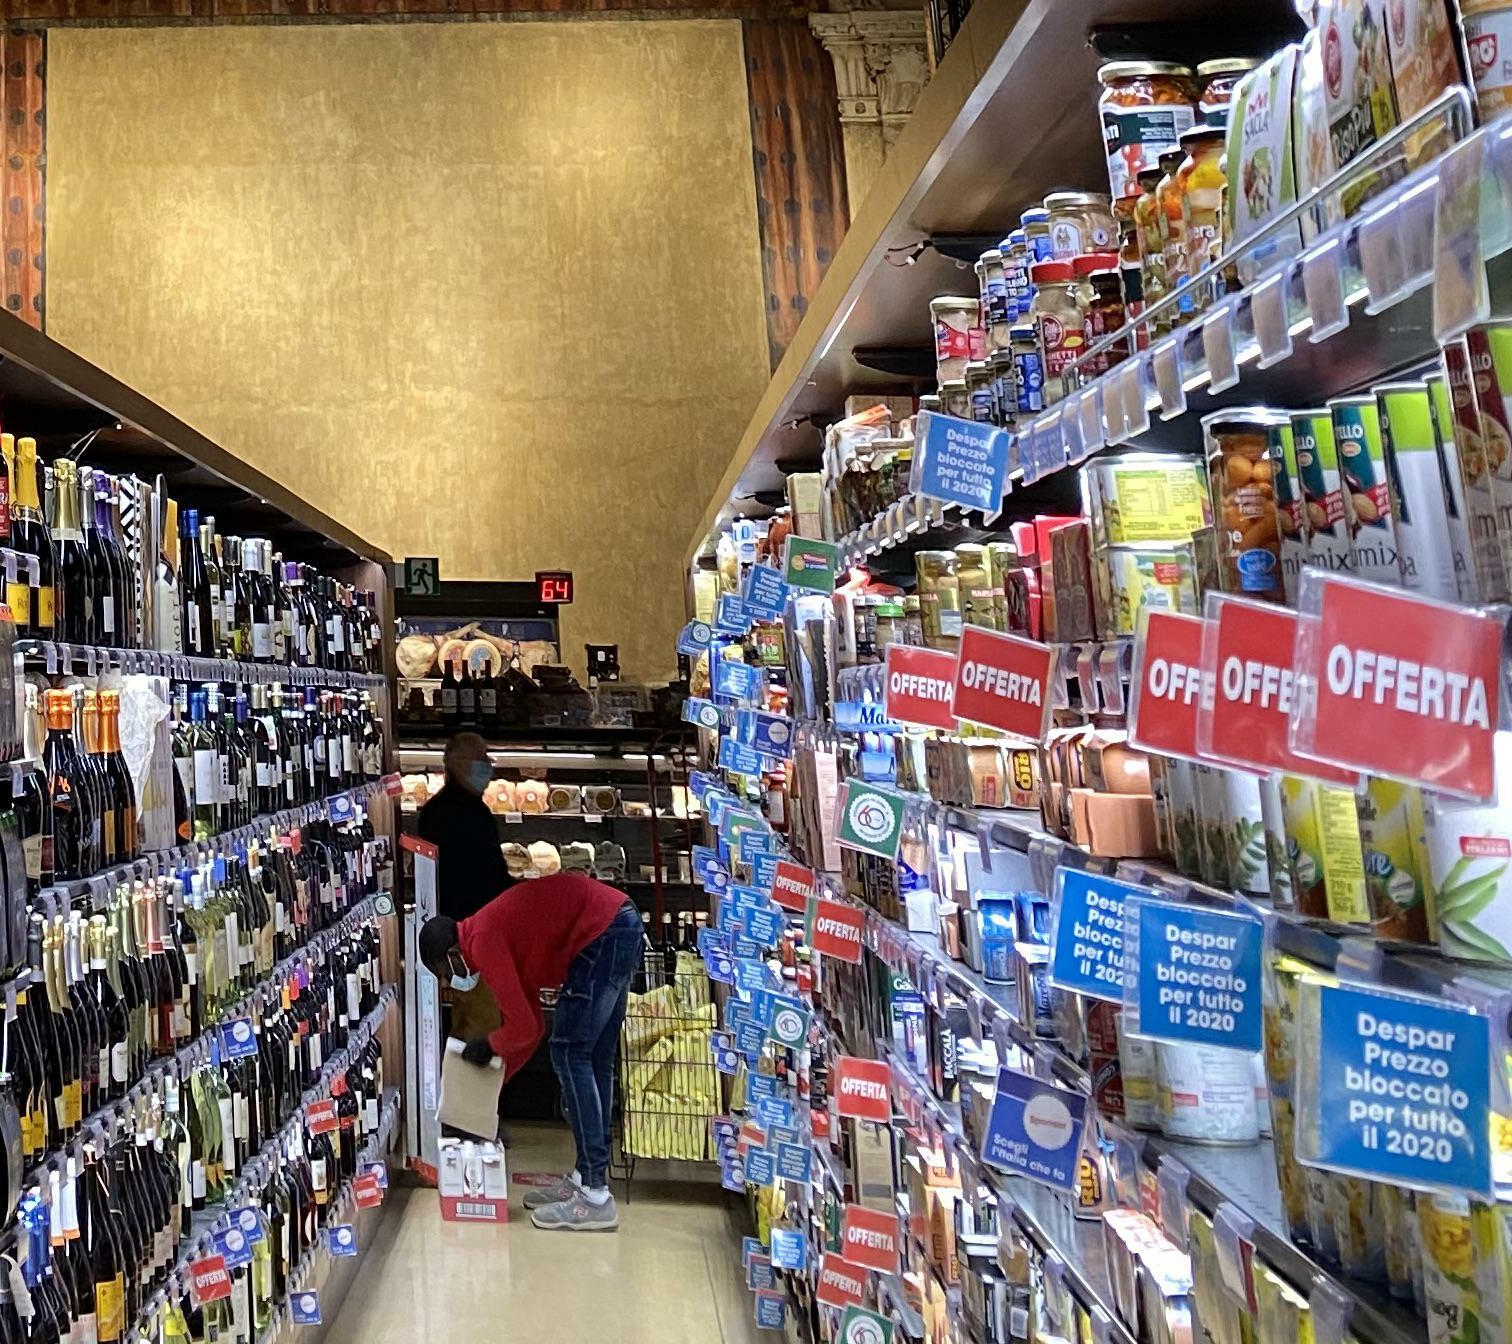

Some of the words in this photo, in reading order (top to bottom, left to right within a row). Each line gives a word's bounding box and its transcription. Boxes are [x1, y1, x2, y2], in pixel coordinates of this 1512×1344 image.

[946, 428, 990, 450] Despa
[947, 441, 988, 461] Prezzo
[937, 451, 996, 476] bloccato
[937, 466, 959, 479] per
[541, 579, 569, 601] 64
[890, 671, 953, 702] OFFERTA
[961, 660, 1042, 708] OFFERTA
[1148, 658, 1216, 712] OFFE
[1222, 655, 1295, 714] OFFE
[1326, 643, 1491, 731] OFFERTA
[775, 875, 812, 898] OFFERTA
[816, 916, 861, 944] OFFERTA
[1165, 924, 1237, 952] Despar
[1073, 942, 1104, 962] per
[1171, 945, 1232, 971] Prezzo
[1080, 959, 1091, 976] il
[1157, 963, 1248, 994] bloccato
[1159, 986, 1194, 1006] per
[1199, 991, 1245, 1014] tutto
[1169, 1006, 1181, 1025] il
[1186, 1009, 1236, 1033] 2020
[1357, 1012, 1456, 1052] Despar
[1364, 1042, 1449, 1079] Prezzo
[840, 1076, 888, 1102] OFFERTA
[1345, 1066, 1469, 1110] bloccato
[1349, 1099, 1395, 1123] per
[1401, 1104, 1466, 1138] tutto
[994, 1132, 1029, 1156] Scegli
[1363, 1125, 1377, 1150] il
[1386, 1130, 1453, 1164] 2020
[847, 1225, 895, 1251] OFFERTA
[822, 1269, 862, 1298] OFFERTA
